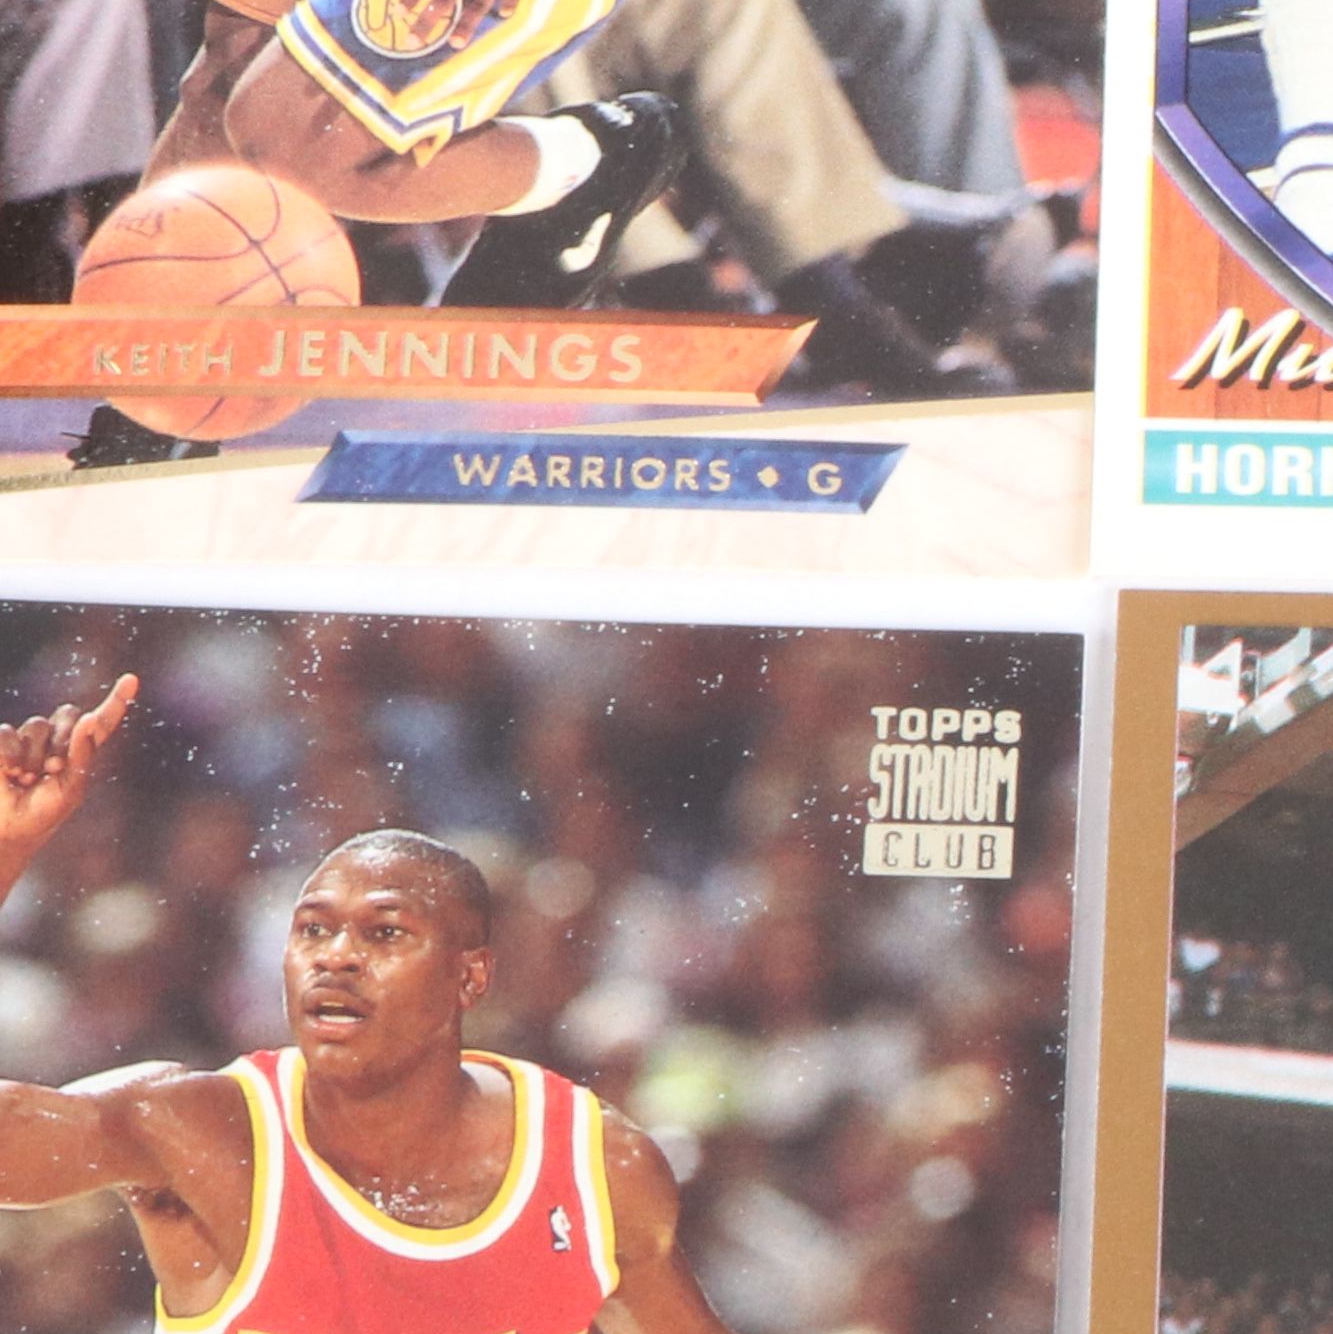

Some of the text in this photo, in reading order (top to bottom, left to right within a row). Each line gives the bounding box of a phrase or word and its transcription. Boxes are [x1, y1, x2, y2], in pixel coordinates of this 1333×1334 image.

[93, 328, 644, 384] KEITH JENNINGS
[453, 452, 843, 496] WARRIORS G
[870, 705, 1022, 744] TOPPS
[867, 743, 1020, 823] STADIUM
[883, 830, 997, 871] CLUB
